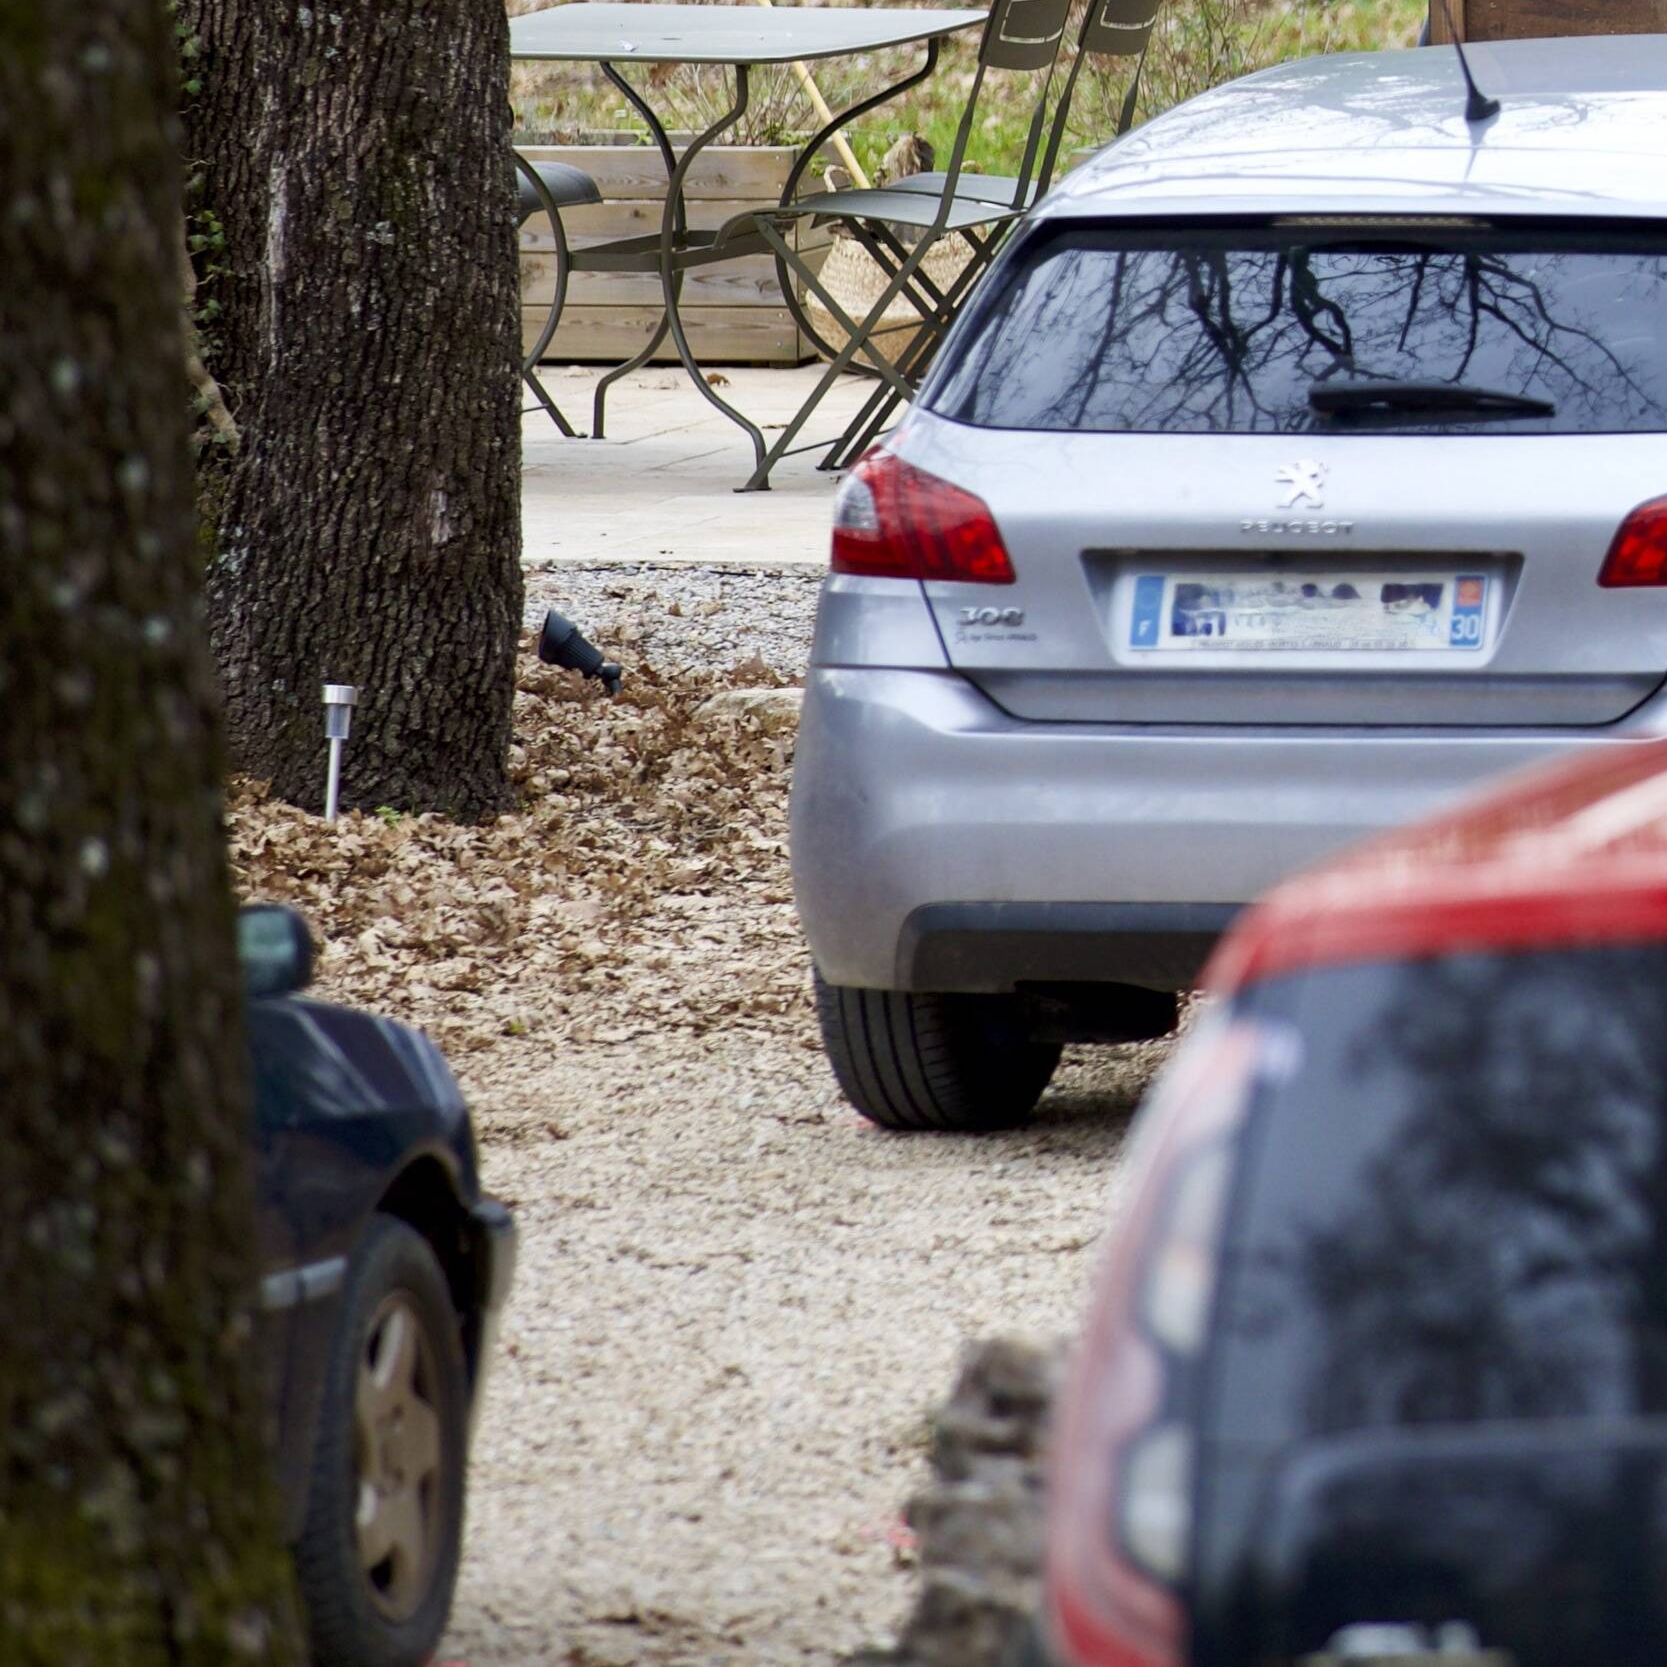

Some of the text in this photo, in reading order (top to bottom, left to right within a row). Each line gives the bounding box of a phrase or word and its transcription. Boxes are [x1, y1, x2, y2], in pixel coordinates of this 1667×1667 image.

[1240, 518, 1355, 535] PEUGEOT
[957, 605, 1025, 627] 308
[1450, 613, 1481, 641] 30
